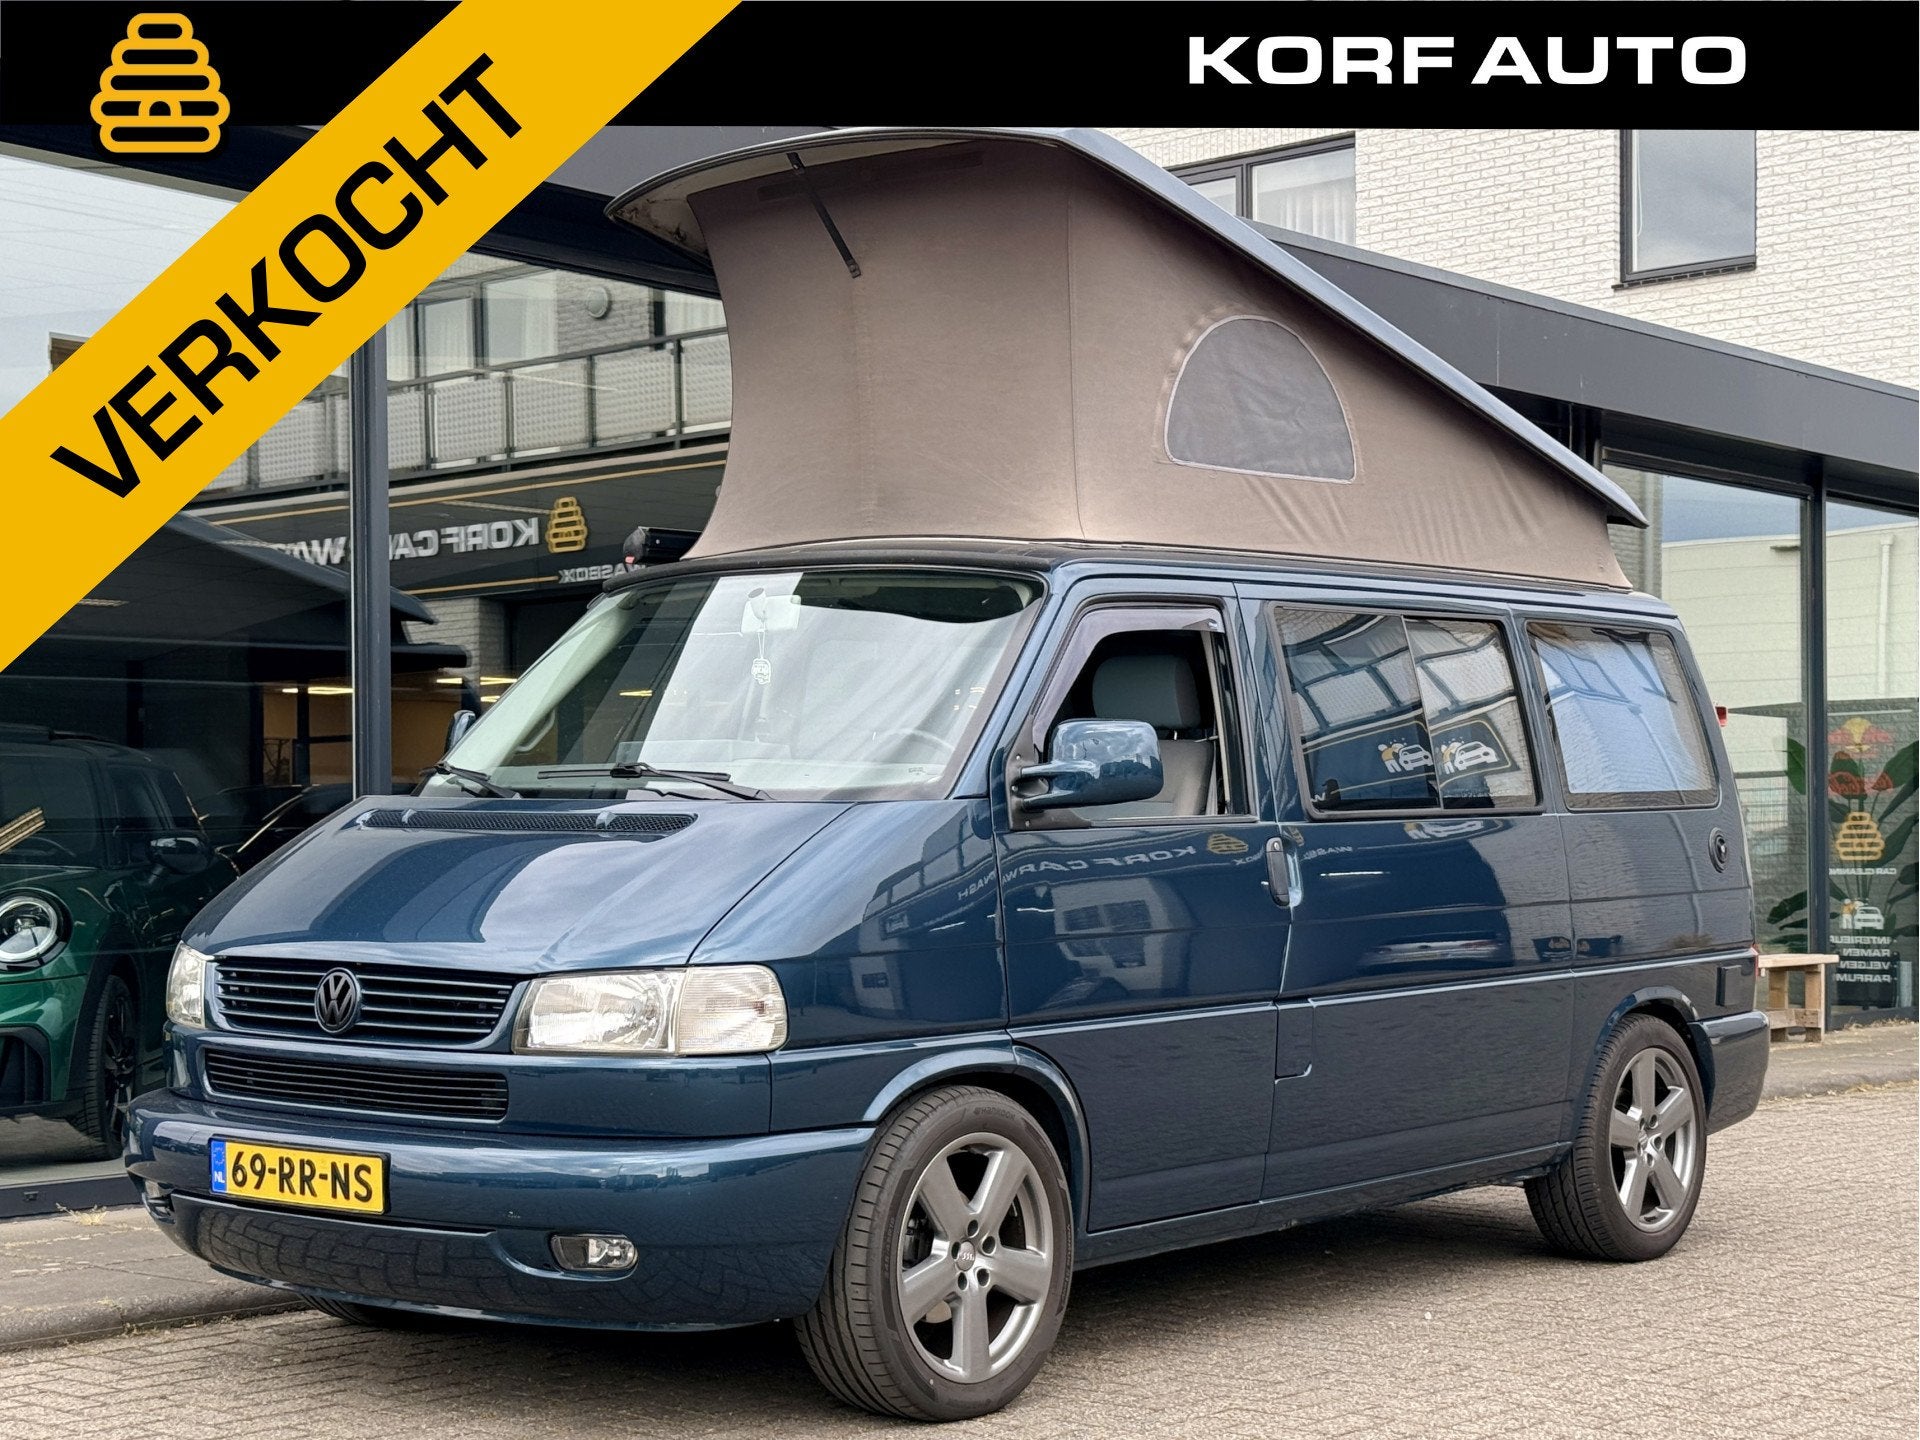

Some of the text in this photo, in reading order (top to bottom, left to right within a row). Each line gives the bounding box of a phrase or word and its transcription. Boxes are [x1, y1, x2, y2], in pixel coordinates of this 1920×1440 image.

[317, 968, 358, 1030] VW
[213, 1151, 373, 1203] NL 69-RR-NS
